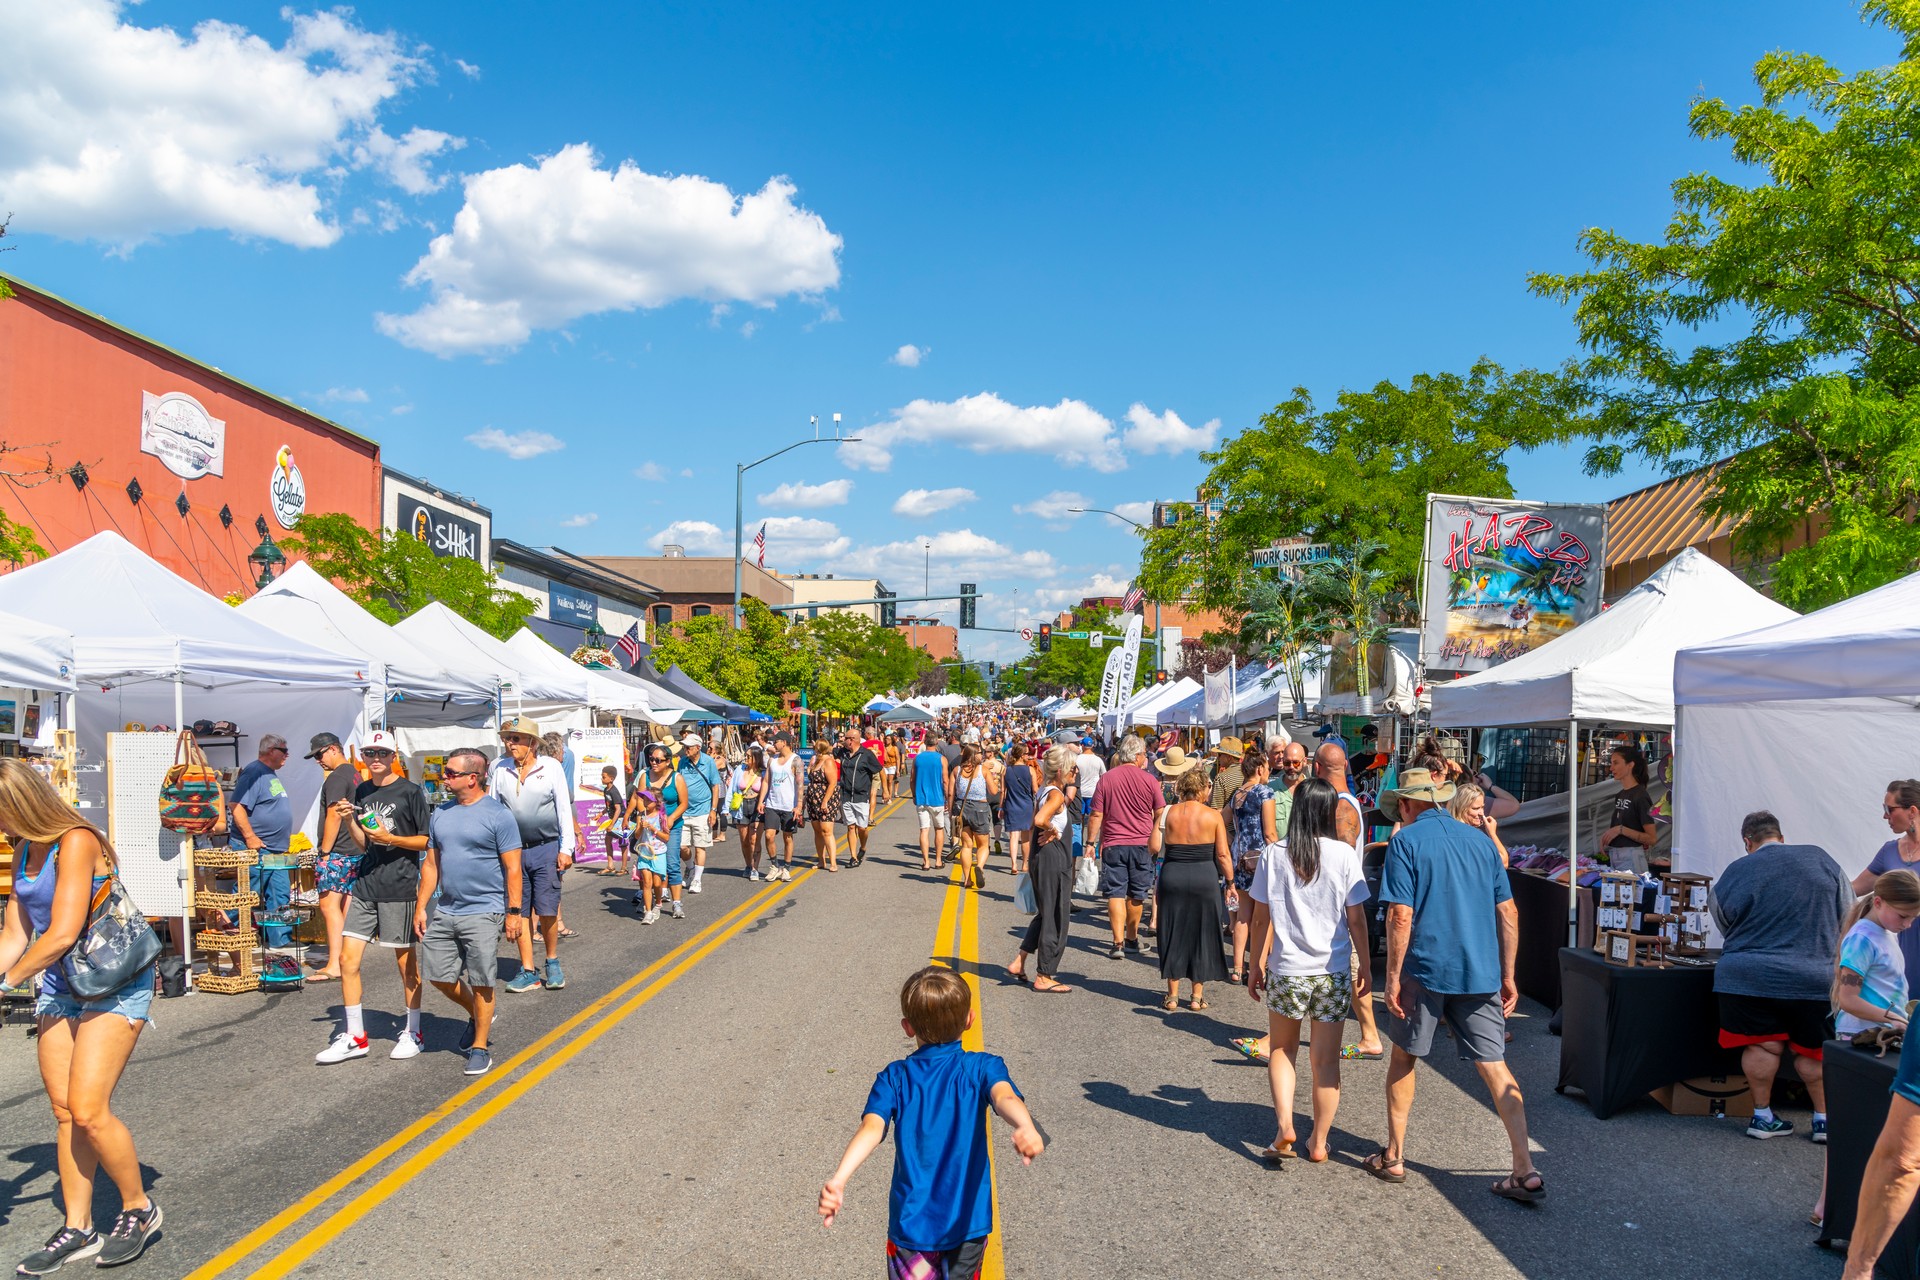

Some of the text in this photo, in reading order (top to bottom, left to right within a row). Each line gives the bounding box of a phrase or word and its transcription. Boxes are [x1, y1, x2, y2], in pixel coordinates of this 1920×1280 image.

[273, 476, 304, 512] Gelato
[435, 522, 475, 560] SHIKI
[1255, 550, 1280, 565] WORK
[1283, 546, 1313, 563] SUCKS
[1550, 566, 1586, 595] Life
[1439, 637, 1472, 667] Half
[1473, 637, 1494, 659] Ass
[1102, 671, 1114, 709] IDAHO
[373, 733, 383, 743] P
